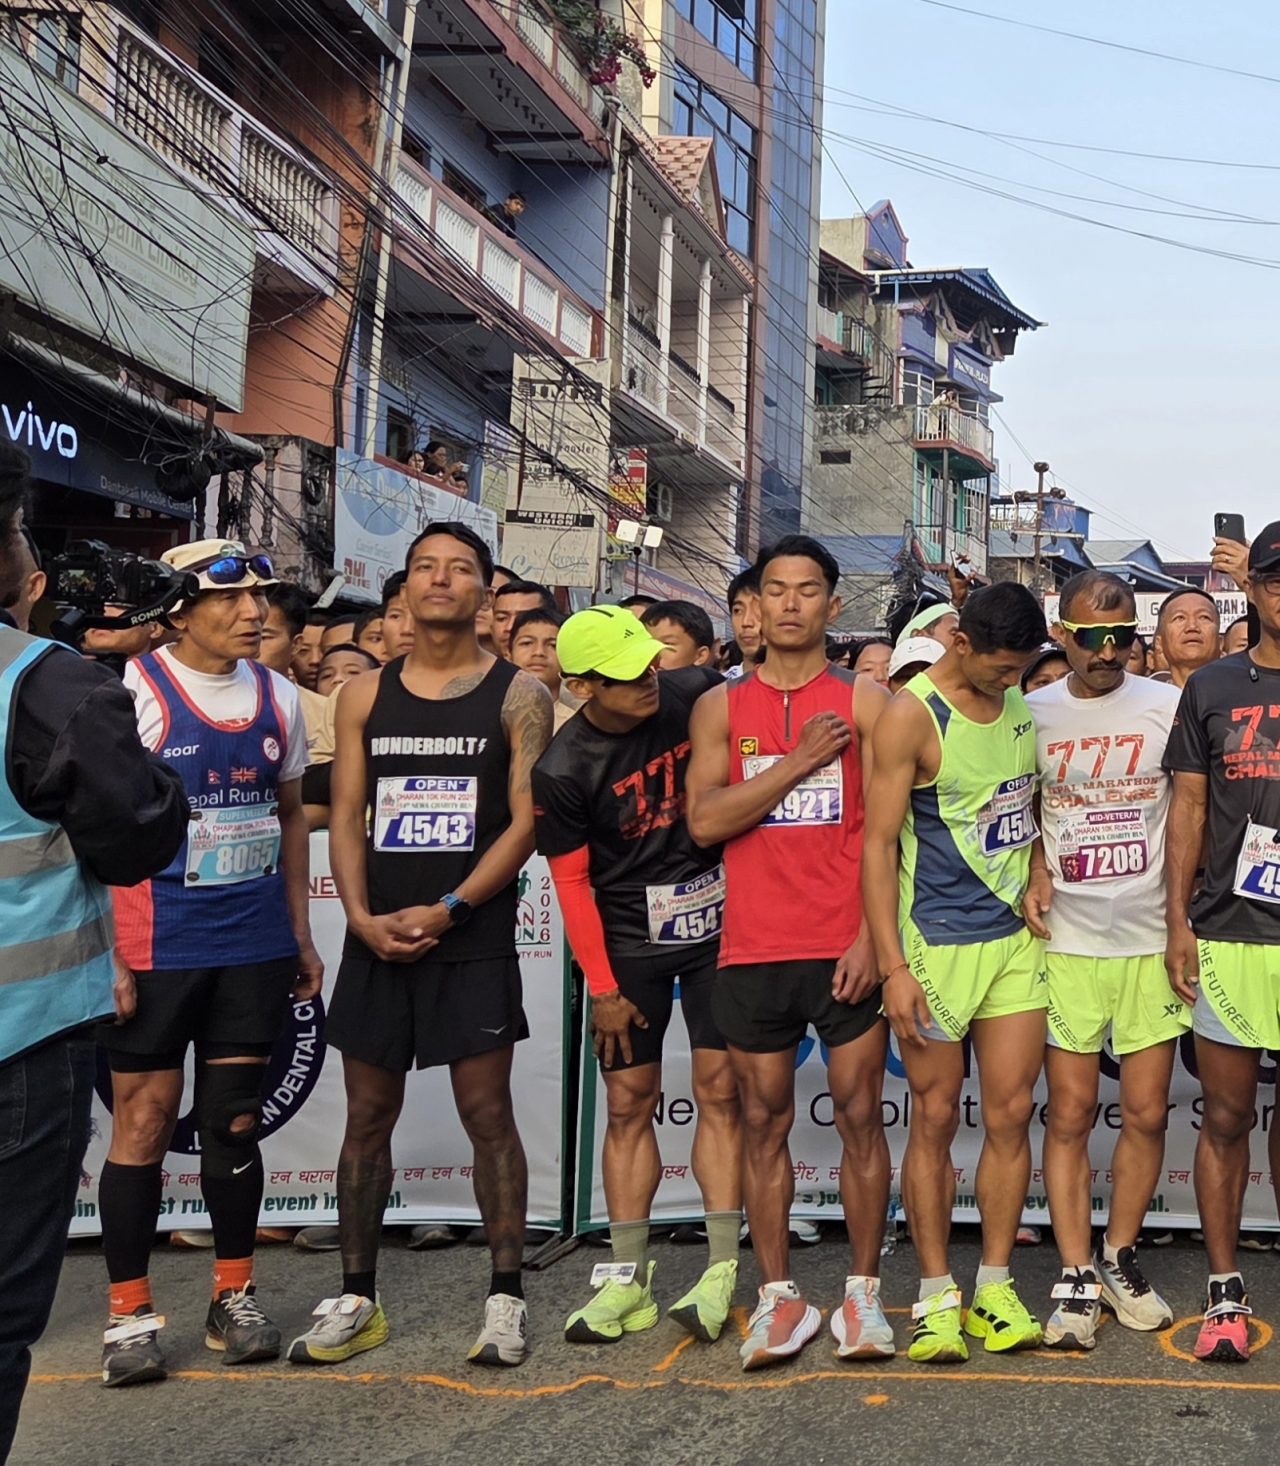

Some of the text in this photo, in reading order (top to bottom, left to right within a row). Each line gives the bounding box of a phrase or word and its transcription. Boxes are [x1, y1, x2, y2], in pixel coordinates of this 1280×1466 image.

[147, 232, 200, 289] Limited
[1, 401, 78, 458] vivo
[140, 487, 168, 509] Mobile
[168, 494, 193, 514] Center
[518, 510, 575, 520] WESTERN
[533, 518, 574, 526] UNION
[130, 606, 165, 626] RONIN
[163, 744, 200, 758] soar
[1047, 734, 1145, 784] 777
[1223, 751, 1264, 765] NEPAL
[415, 780, 458, 790] OPEN
[1083, 776, 1159, 790] MARATHON
[187, 788, 223, 808] epal
[229, 788, 260, 803] Run
[1046, 788, 1158, 810] CHALLENGE
[1089, 811, 1140, 822] MID-VETERAN
[397, 815, 468, 845] 4543
[1074, 825, 1100, 835] DHARAN
[1113, 823, 1128, 831] RUN
[216, 840, 274, 876] 8065
[1081, 843, 1144, 877] 7208
[685, 872, 714, 893] OPEN
[673, 905, 724, 940] 454
[912, 950, 955, 1025] THE FUTURE
[1200, 939, 1242, 1025] THE FUTURE
[279, 1024, 317, 1107] DENTAL
[270, 1170, 293, 1184] रन
[403, 1167, 425, 1181] रन
[432, 1166, 453, 1179] रन
[264, 1192, 318, 1211] event
